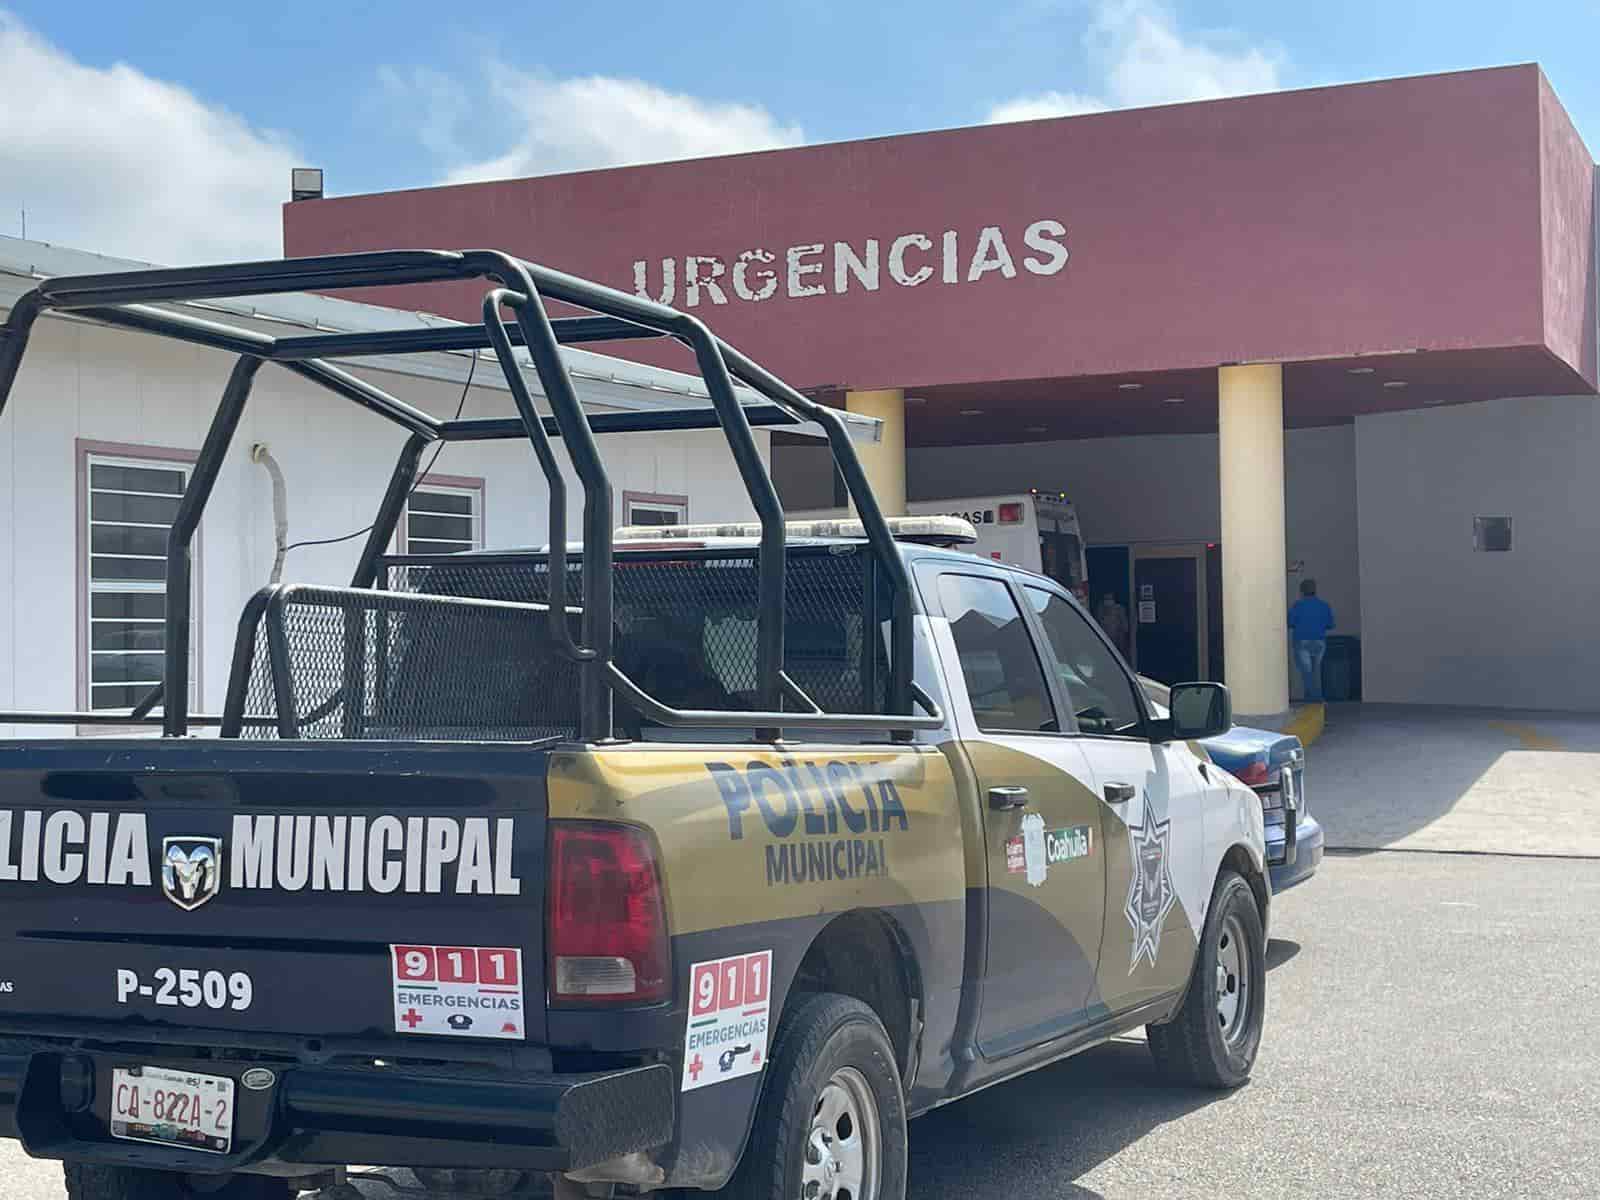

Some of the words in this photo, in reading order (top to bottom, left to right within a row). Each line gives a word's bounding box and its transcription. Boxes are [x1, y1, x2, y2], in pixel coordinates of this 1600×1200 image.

[632, 220, 1069, 306] URGENCIAS
[704, 759, 909, 840] POLICIA
[0, 810, 152, 885] LICIA
[230, 815, 520, 895] MUNICIPAL
[765, 840, 888, 886] MUNICIPAL
[1047, 829, 1088, 863] Coahuila
[116, 967, 253, 1010] P-2509
[398, 992, 520, 1010] EMERGENCIAS
[689, 1019, 766, 1050] EMERGENCIAS
[117, 1083, 228, 1129] CA-822A-2
